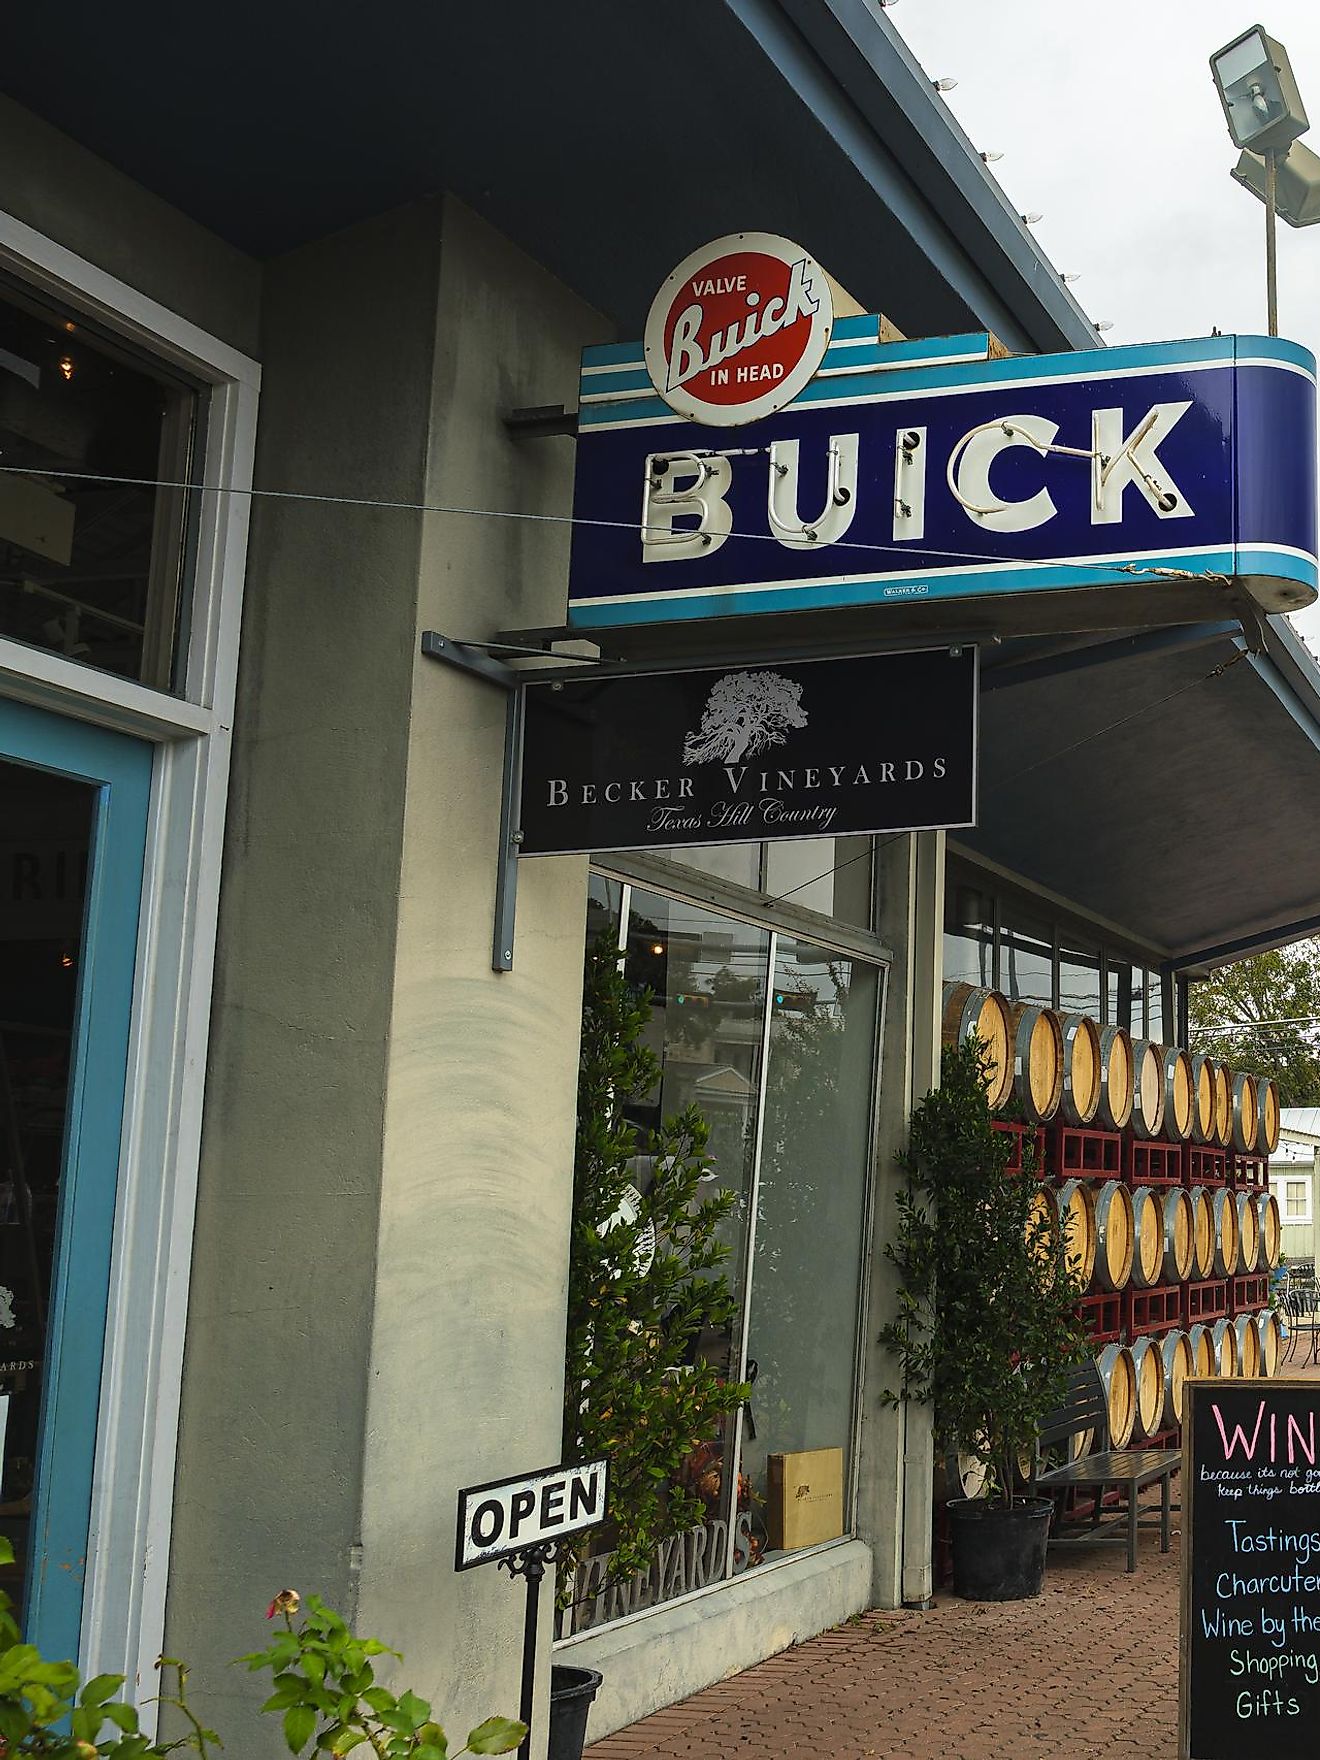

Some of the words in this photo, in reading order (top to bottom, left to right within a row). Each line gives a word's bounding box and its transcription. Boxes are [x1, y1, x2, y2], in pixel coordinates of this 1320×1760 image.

[692, 275, 747, 297] VALVE
[666, 258, 821, 394] Buick
[710, 368, 729, 386] IN
[736, 363, 784, 383] HEAD
[642, 401, 1195, 562] BUICK
[547, 778, 695, 807] BECKER
[724, 757, 947, 795] VINEYARDS
[646, 805, 701, 831] Texas
[706, 801, 754, 829] Hill
[759, 797, 838, 829] Country
[1200, 1464, 1252, 1480] because
[1280, 1467, 1300, 1479] not
[1246, 1483, 1283, 1500] things
[470, 1471, 598, 1548] OPEN
[1202, 1608, 1254, 1639] Wine
[1261, 1609, 1287, 1648] by
[1229, 1649, 1319, 1684] Shopping
[1236, 1690, 1301, 1719] Gifts
